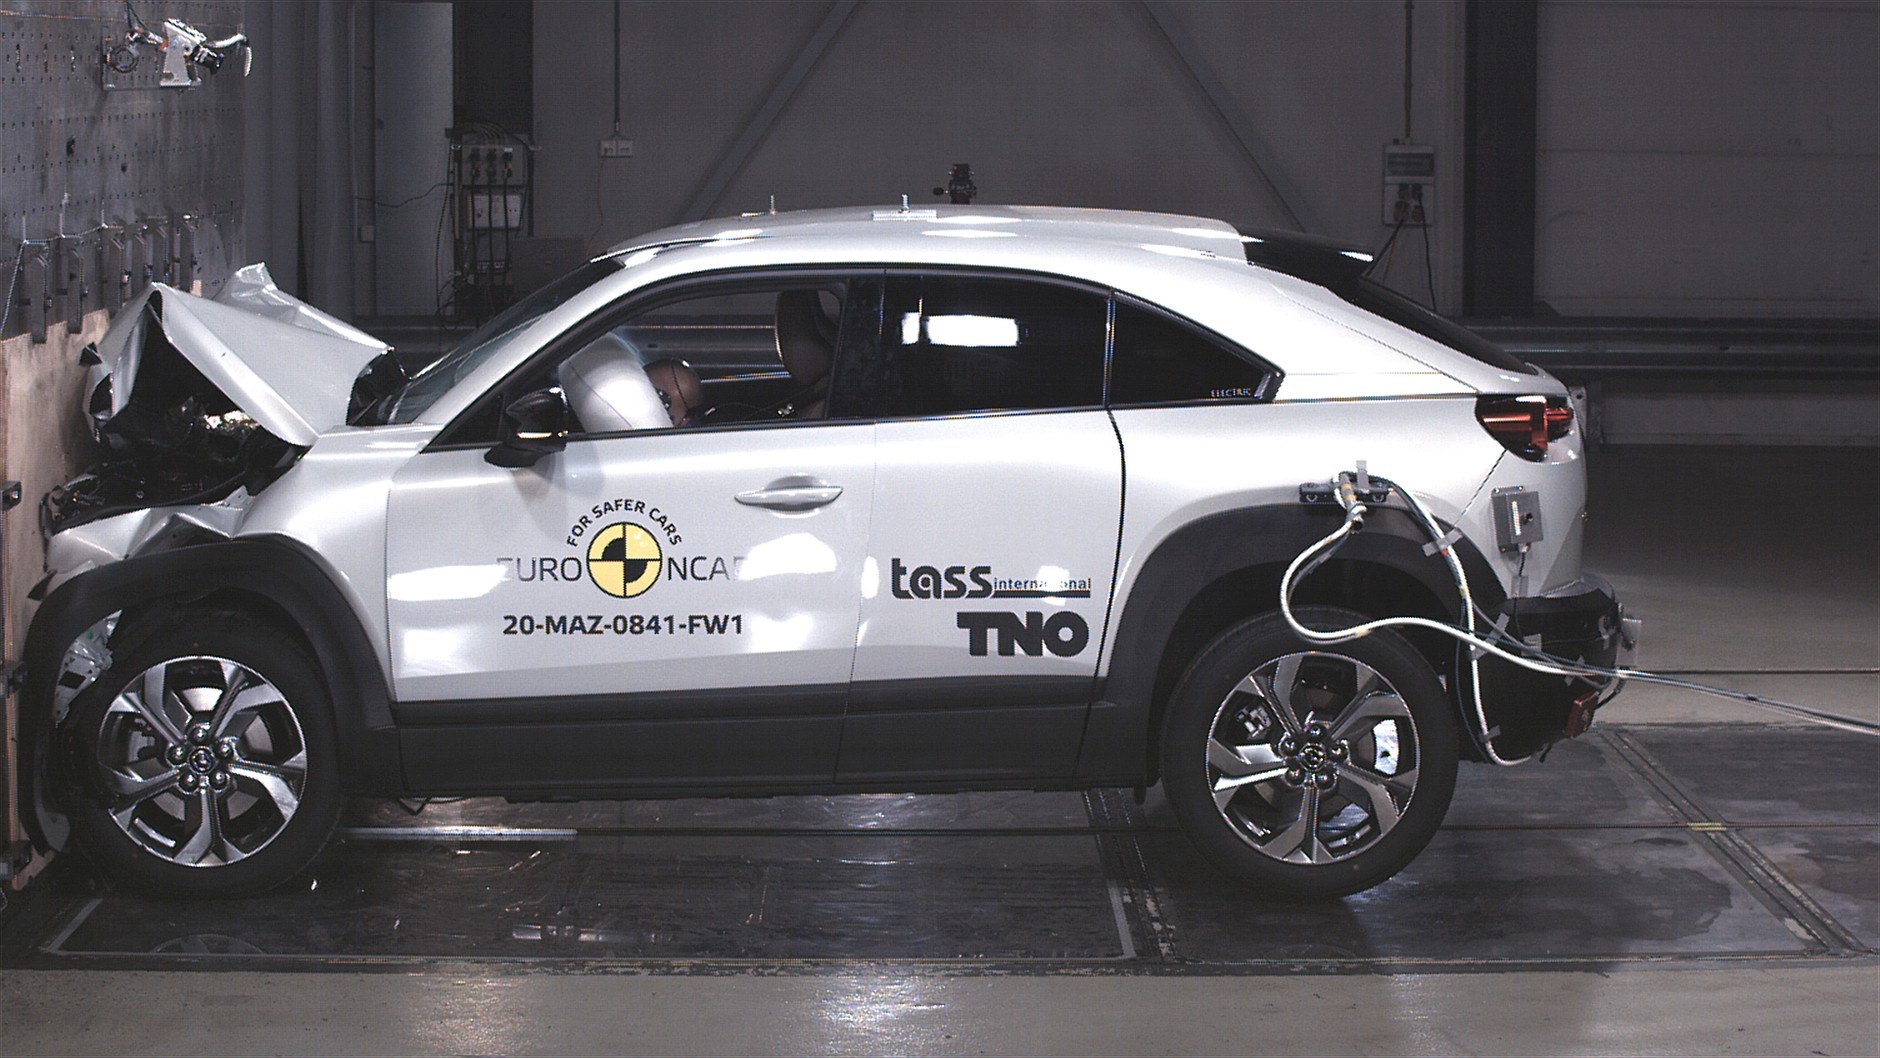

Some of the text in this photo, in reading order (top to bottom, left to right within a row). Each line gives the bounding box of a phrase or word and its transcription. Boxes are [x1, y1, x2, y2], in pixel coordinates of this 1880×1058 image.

[566, 498, 682, 547] FOR SAFER CARS
[891, 557, 993, 600] tass
[502, 614, 742, 635] 20-MAZ-0841-FW1
[956, 610, 1090, 658] TNO
